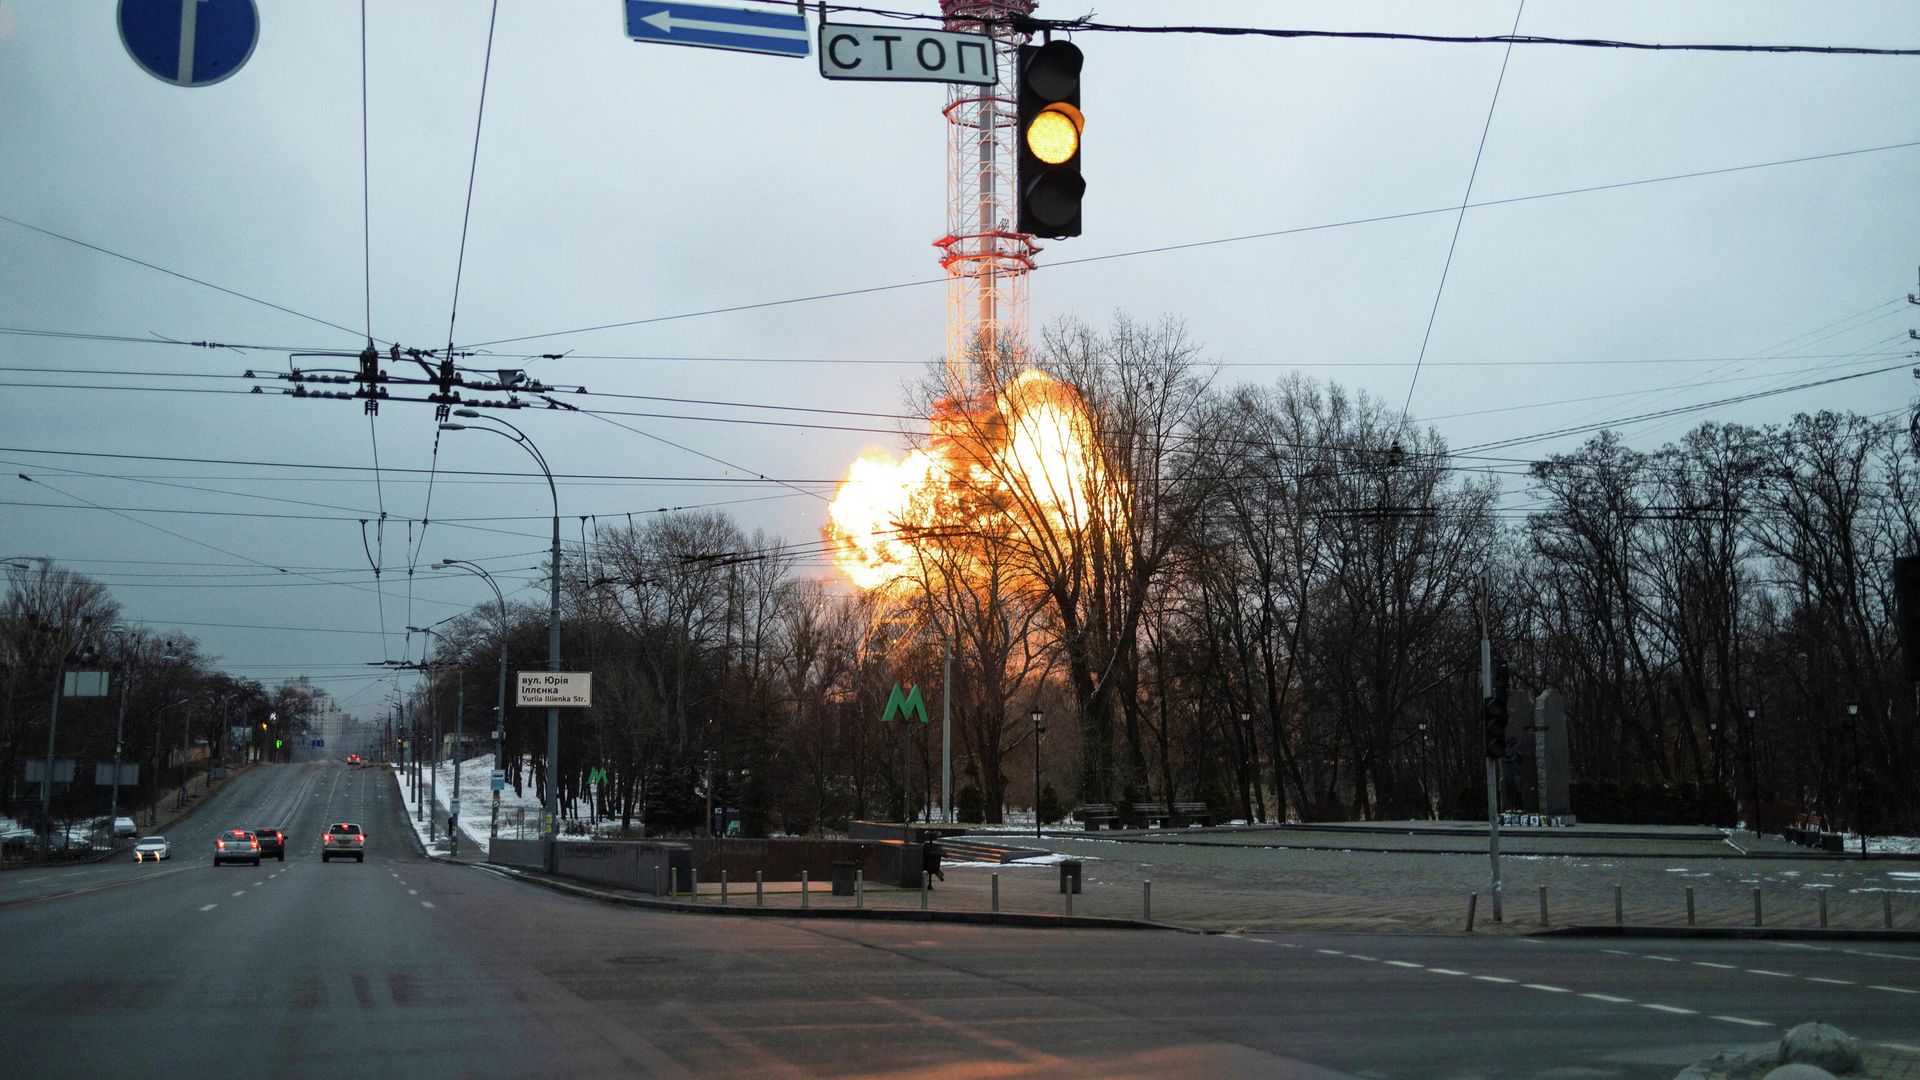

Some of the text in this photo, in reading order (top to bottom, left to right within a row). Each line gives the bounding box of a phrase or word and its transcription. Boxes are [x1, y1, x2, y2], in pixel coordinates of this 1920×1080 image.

[829, 34, 988, 76] СТОП
[522, 675, 569, 686] вул. Юрія
[521, 686, 559, 694] Іллєнка
[573, 695, 587, 703] Str.
